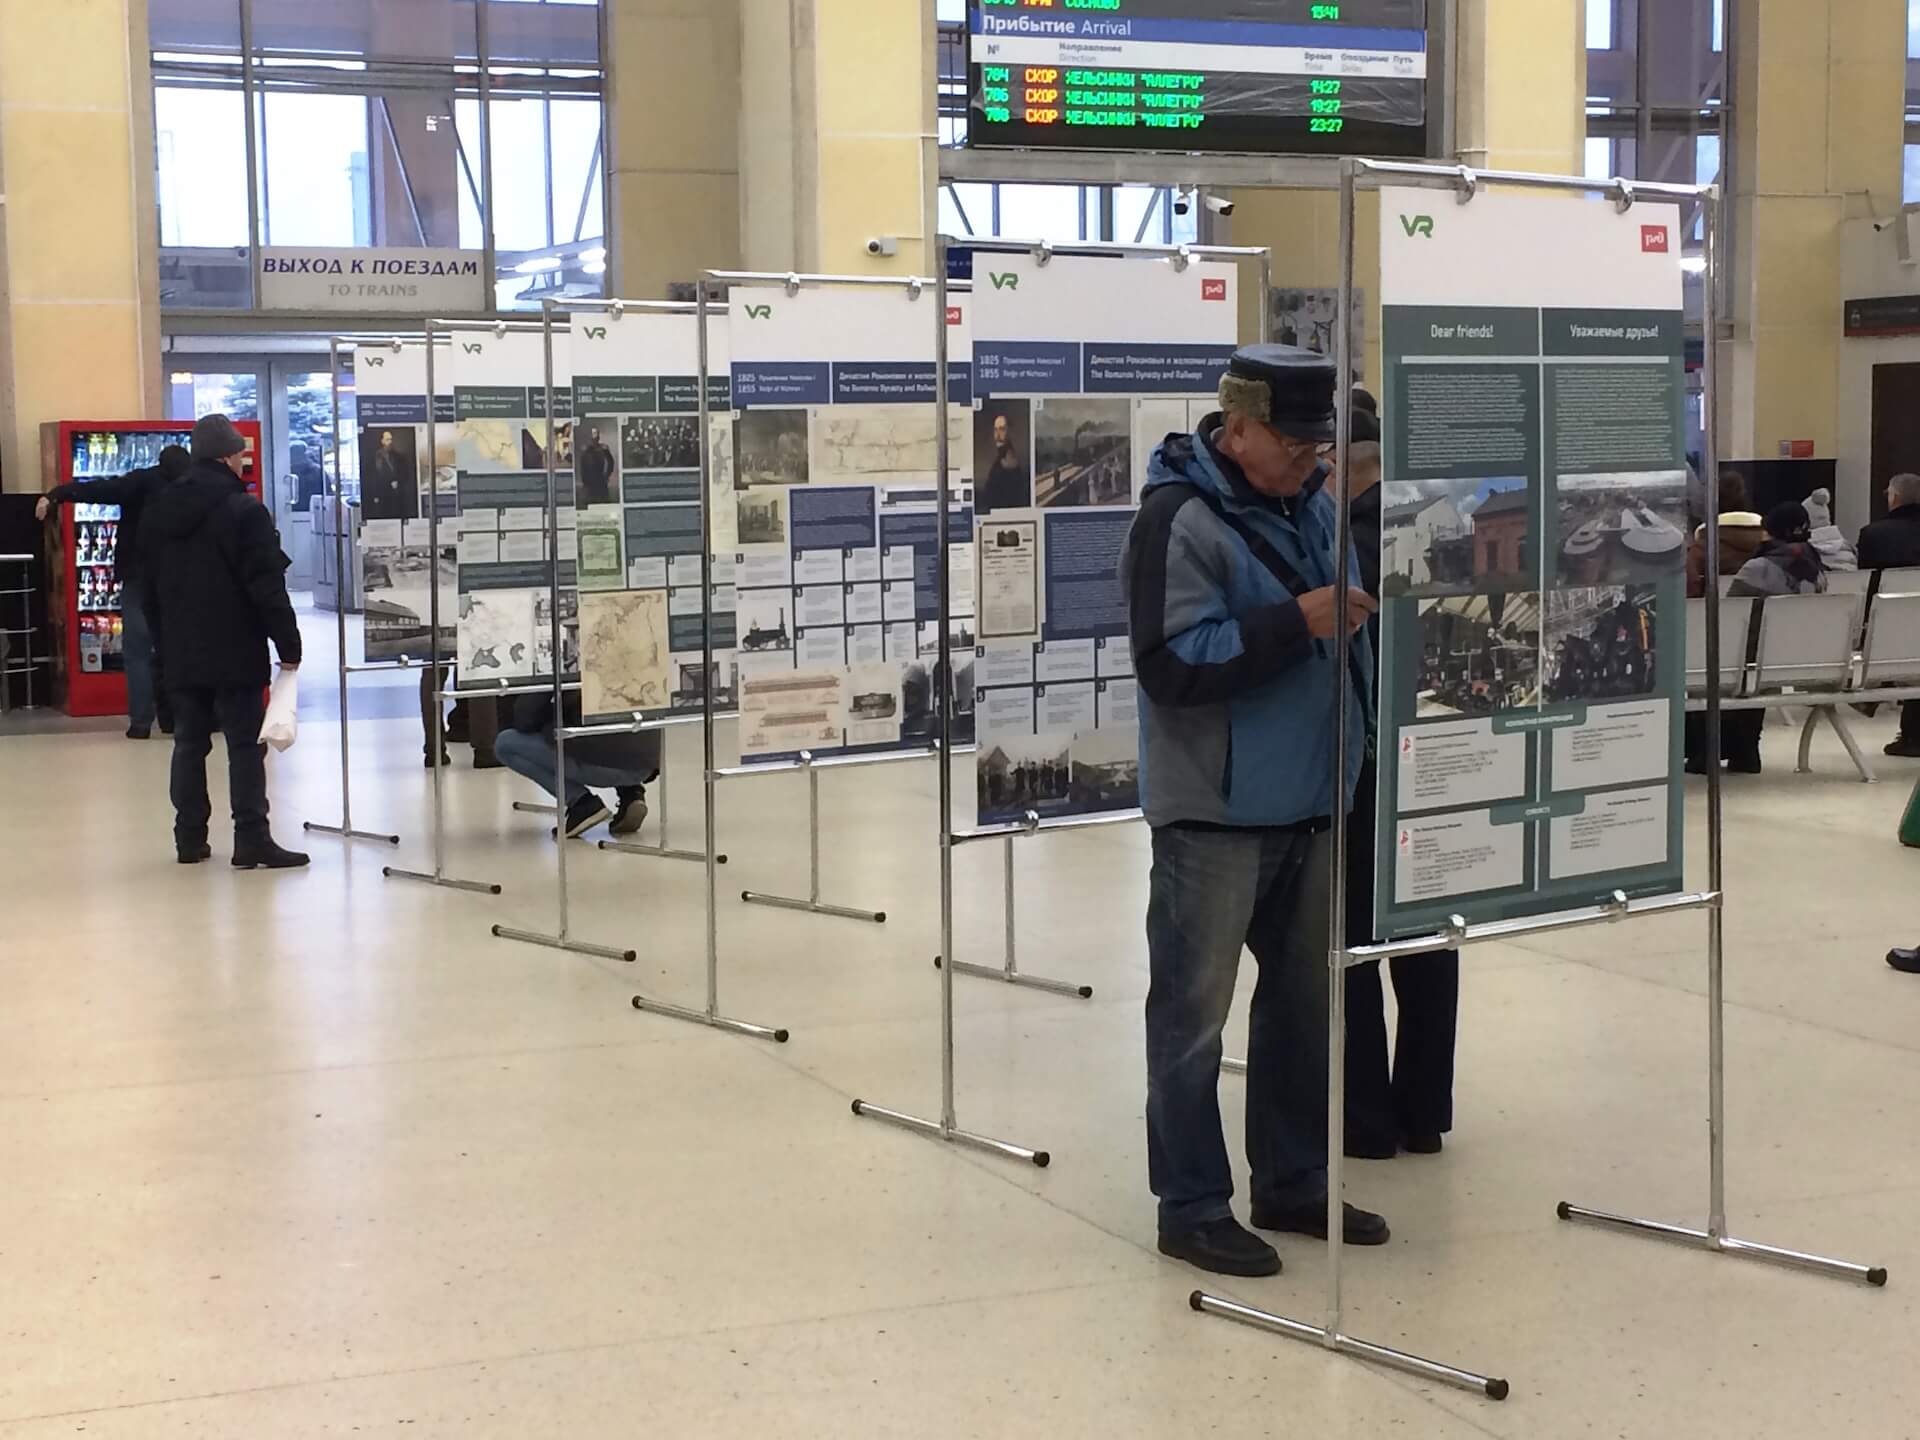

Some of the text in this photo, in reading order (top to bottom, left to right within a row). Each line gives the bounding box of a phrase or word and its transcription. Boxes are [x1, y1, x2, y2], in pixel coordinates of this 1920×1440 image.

[983, 15, 1132, 37] Прибытие Arrival
[1393, 55, 1414, 65] Путь
[1025, 68, 1057, 83] СКОР
[1065, 69, 1136, 86] ХЕЛЬСИНКИ
[1310, 80, 1341, 94] 14:27
[1025, 89, 1057, 104] СКОР
[1065, 90, 1136, 107] ХЕЛЬСИНКИ
[1310, 99, 1341, 113] 19:27
[1025, 109, 1057, 124] СКОР
[1065, 110, 1136, 127] ХЕЛЬСИНКИ
[1310, 118, 1342, 132] 23:27
[1400, 214, 1434, 238] VR
[263, 258, 478, 276] ВЫХОД К ПОЕЗДАМ
[989, 272, 1019, 290] VR
[328, 284, 418, 297] TO TRAINS
[745, 304, 772, 319] VR
[584, 326, 607, 340] VR
[1431, 324, 1494, 338] Dear friends!
[1570, 324, 1659, 340] Уважаемые друзья!
